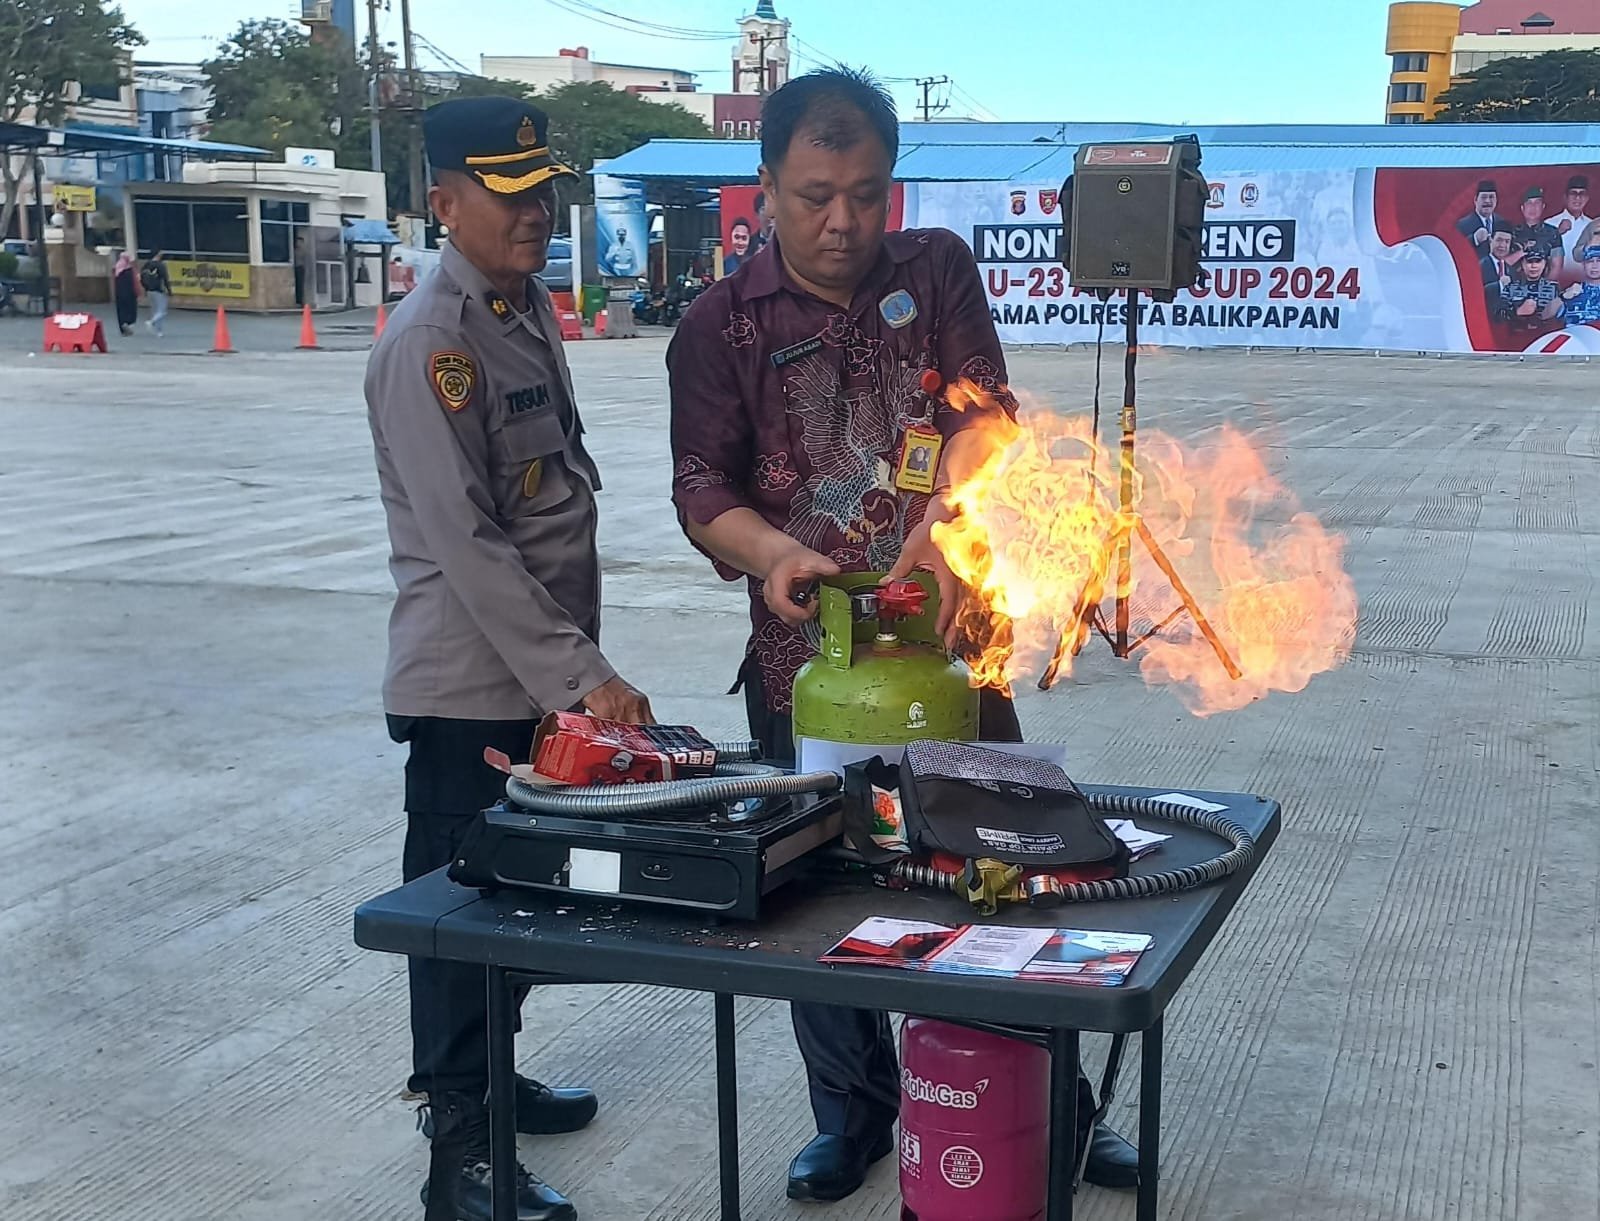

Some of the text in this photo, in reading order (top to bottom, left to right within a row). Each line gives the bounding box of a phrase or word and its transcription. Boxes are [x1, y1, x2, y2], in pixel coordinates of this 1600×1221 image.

[983, 228, 1064, 259] NON
[988, 266, 1361, 300] U-23 CUP 2024
[1047, 303, 1166, 325] POLRESTA
[1172, 304, 1340, 329] BALIKPAPAN
[505, 384, 550, 415] TEGUH
[978, 829, 1018, 841] PRIME
